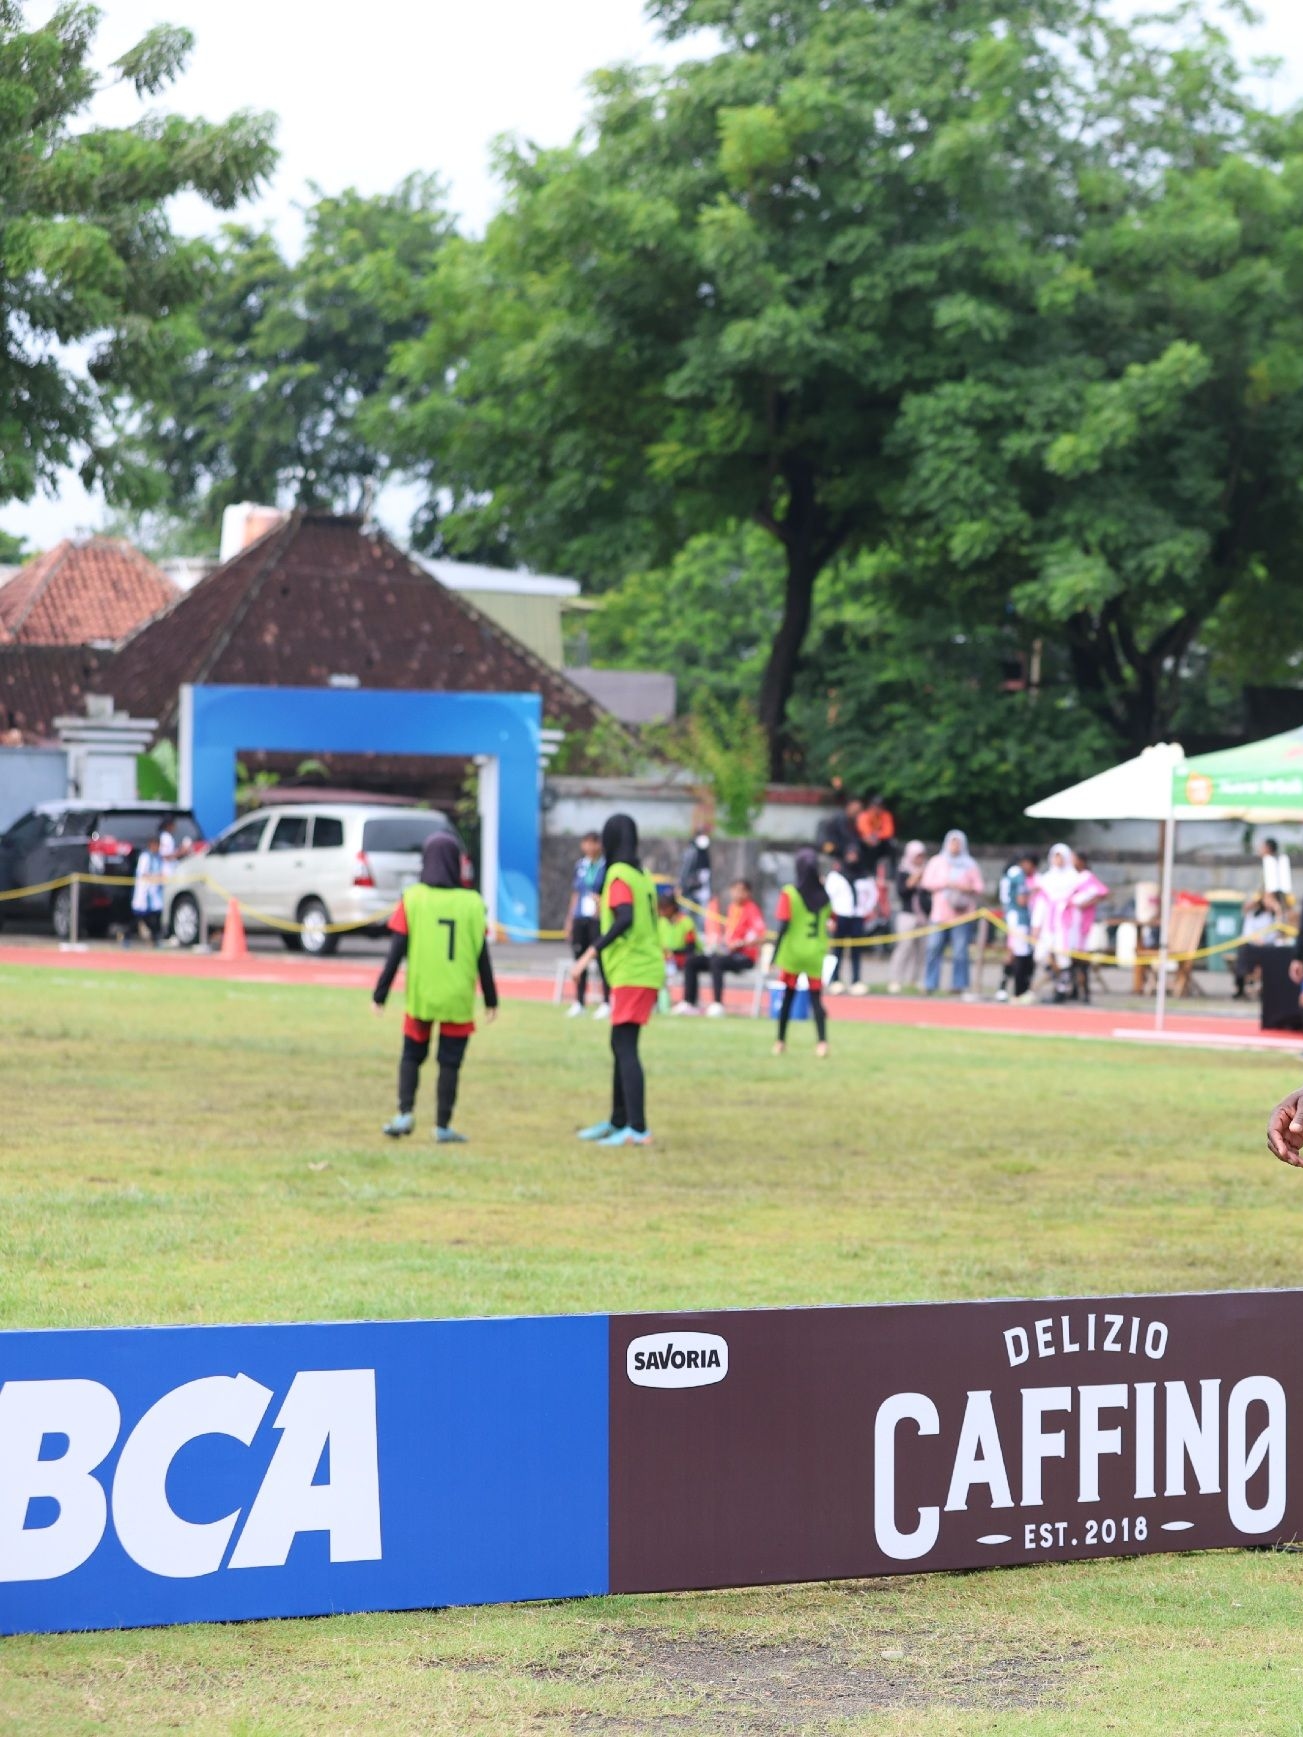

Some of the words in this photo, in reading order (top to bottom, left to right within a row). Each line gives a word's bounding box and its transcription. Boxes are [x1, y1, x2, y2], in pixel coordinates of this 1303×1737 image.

[438, 918, 455, 961] 7
[634, 1343, 721, 1371] SAVORIA
[1003, 1313, 1168, 1367] DELIZIO
[0, 1368, 382, 1582] BCA
[874, 1375, 1287, 1560] CAFFINO
[1024, 1522, 1077, 1550] EST.
[1085, 1516, 1148, 1544] 2018
